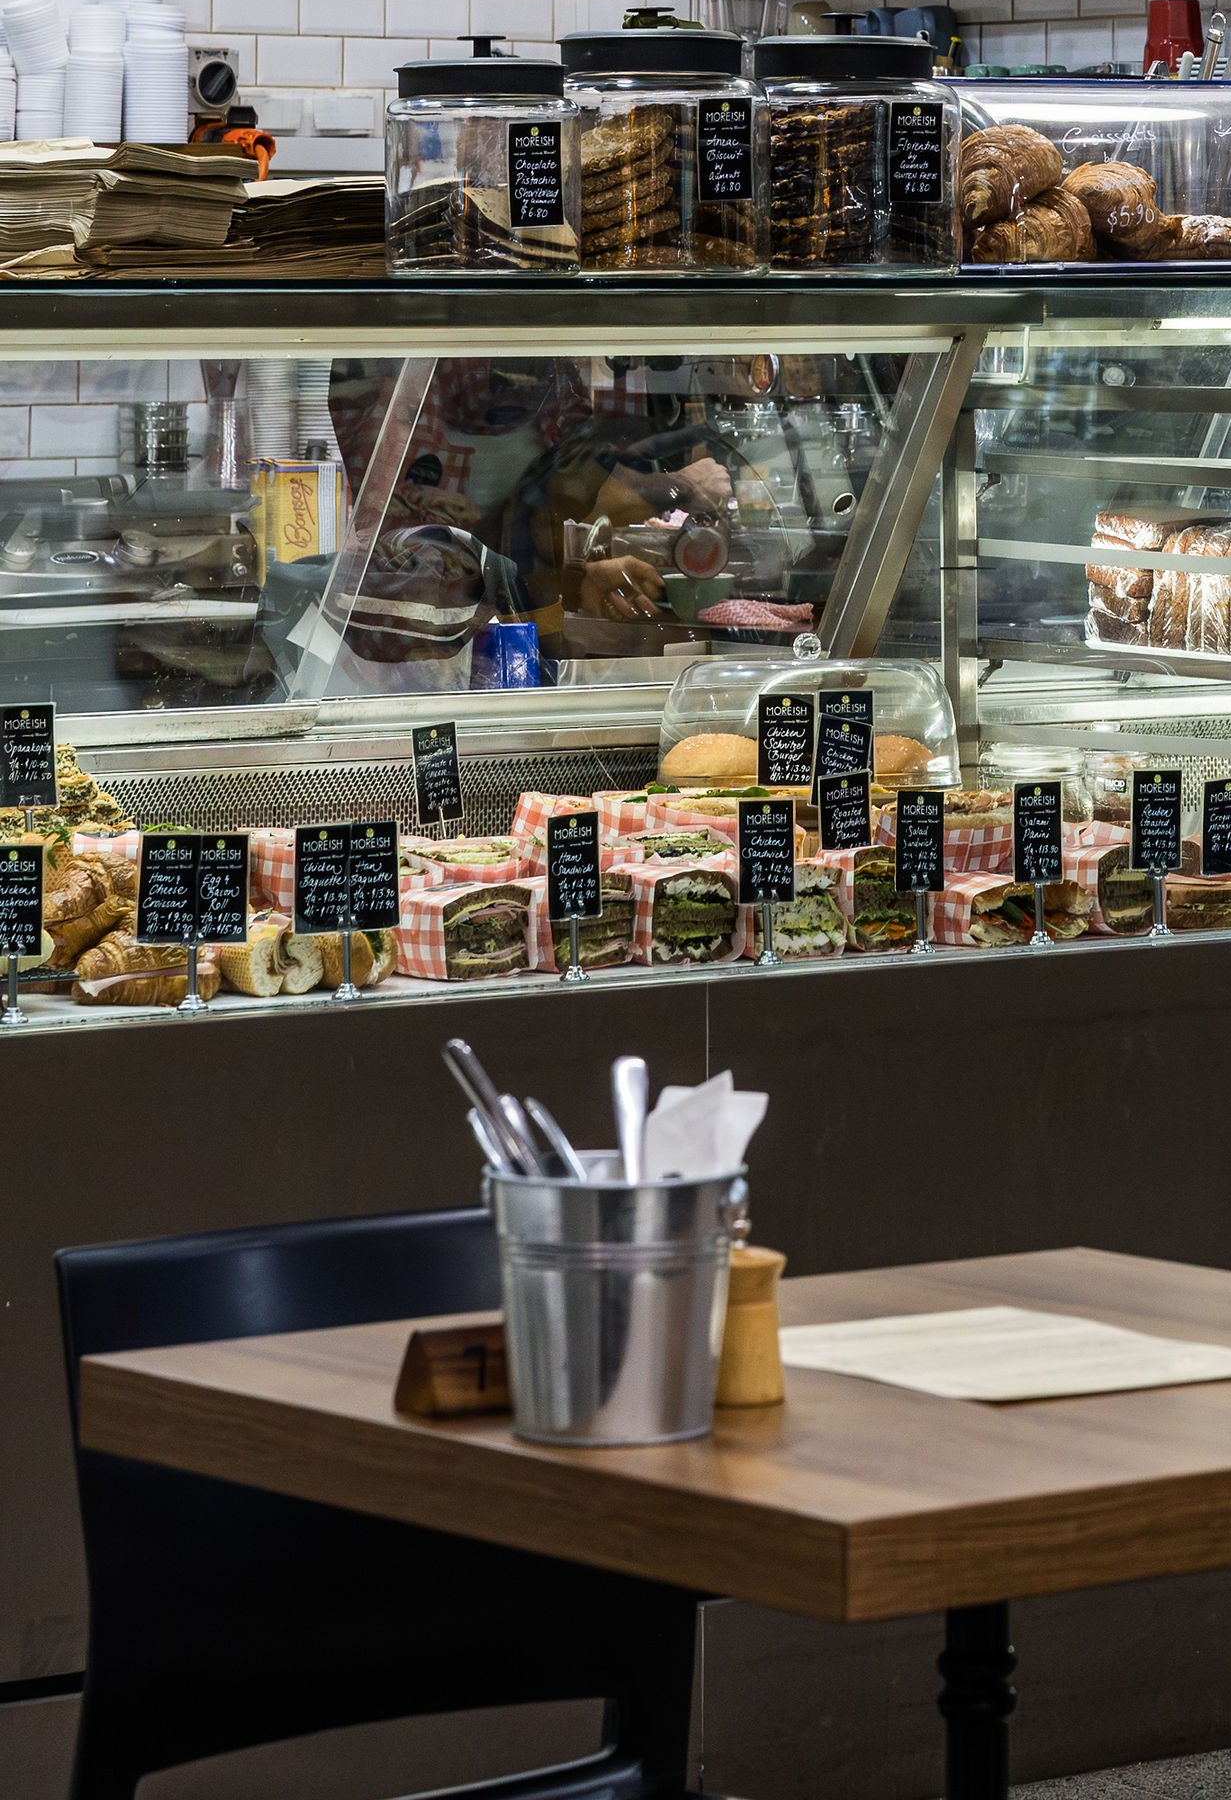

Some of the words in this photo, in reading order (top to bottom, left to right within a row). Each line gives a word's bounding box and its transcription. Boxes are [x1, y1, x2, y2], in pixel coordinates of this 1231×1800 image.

[705, 111, 745, 122] MOREISH
[897, 115, 936, 126] MOREISH
[515, 136, 555, 147] MOREISH
[706, 134, 740, 147] Anzac
[896, 137, 941, 153] Florentine
[706, 149, 744, 162] Biscuit
[515, 159, 557, 170] Chocolate
[515, 172, 557, 186] Pistachio
[714, 182, 741, 193] $6.80
[904, 182, 931, 194] $6.80
[520, 205, 549, 220] $6.80
[1107, 204, 1156, 233] $5.90
[284, 477, 316, 549] Bonsoy
[766, 706, 808, 716] MOREISH
[826, 703, 866, 713] MOREISH
[4, 719, 47, 730] MOREISH
[766, 726, 806, 738] Chicken
[825, 728, 864, 746] MOREISH
[418, 735, 451, 750] MOREISH
[763, 737, 807, 752] Schnitzel
[767, 749, 804, 764] Burger
[826, 748, 858, 764] Chicken
[826, 785, 864, 801] MOREISH
[1139, 783, 1176, 794] MOREISH
[1020, 795, 1056, 807] MOREISH
[832, 807, 864, 820] Roasted
[903, 804, 939, 815] MOREISH
[1141, 804, 1174, 818] Reuben
[747, 814, 788, 825] MOREISH
[554, 825, 592, 840] MOREISH
[1022, 827, 1051, 841] Panini
[303, 838, 343, 853] MOREISH
[350, 836, 391, 850] MOREISH
[750, 835, 786, 847] Chicken
[149, 849, 193, 860] MOREISH
[200, 849, 242, 860] MOREISH
[741, 848, 790, 860] Sandwich
[0, 860, 36, 873] OREISH
[303, 861, 343, 875] Chicken
[551, 860, 594, 876] Sandwich
[148, 872, 175, 884] Ham
[202, 873, 222, 887] Egg
[299, 875, 347, 894] Baguette
[348, 872, 393, 889] Baguette
[149, 883, 188, 895] Cheese
[200, 884, 240, 900] Bacon
[142, 896, 188, 909] Croissant
[208, 898, 229, 911] Roll
